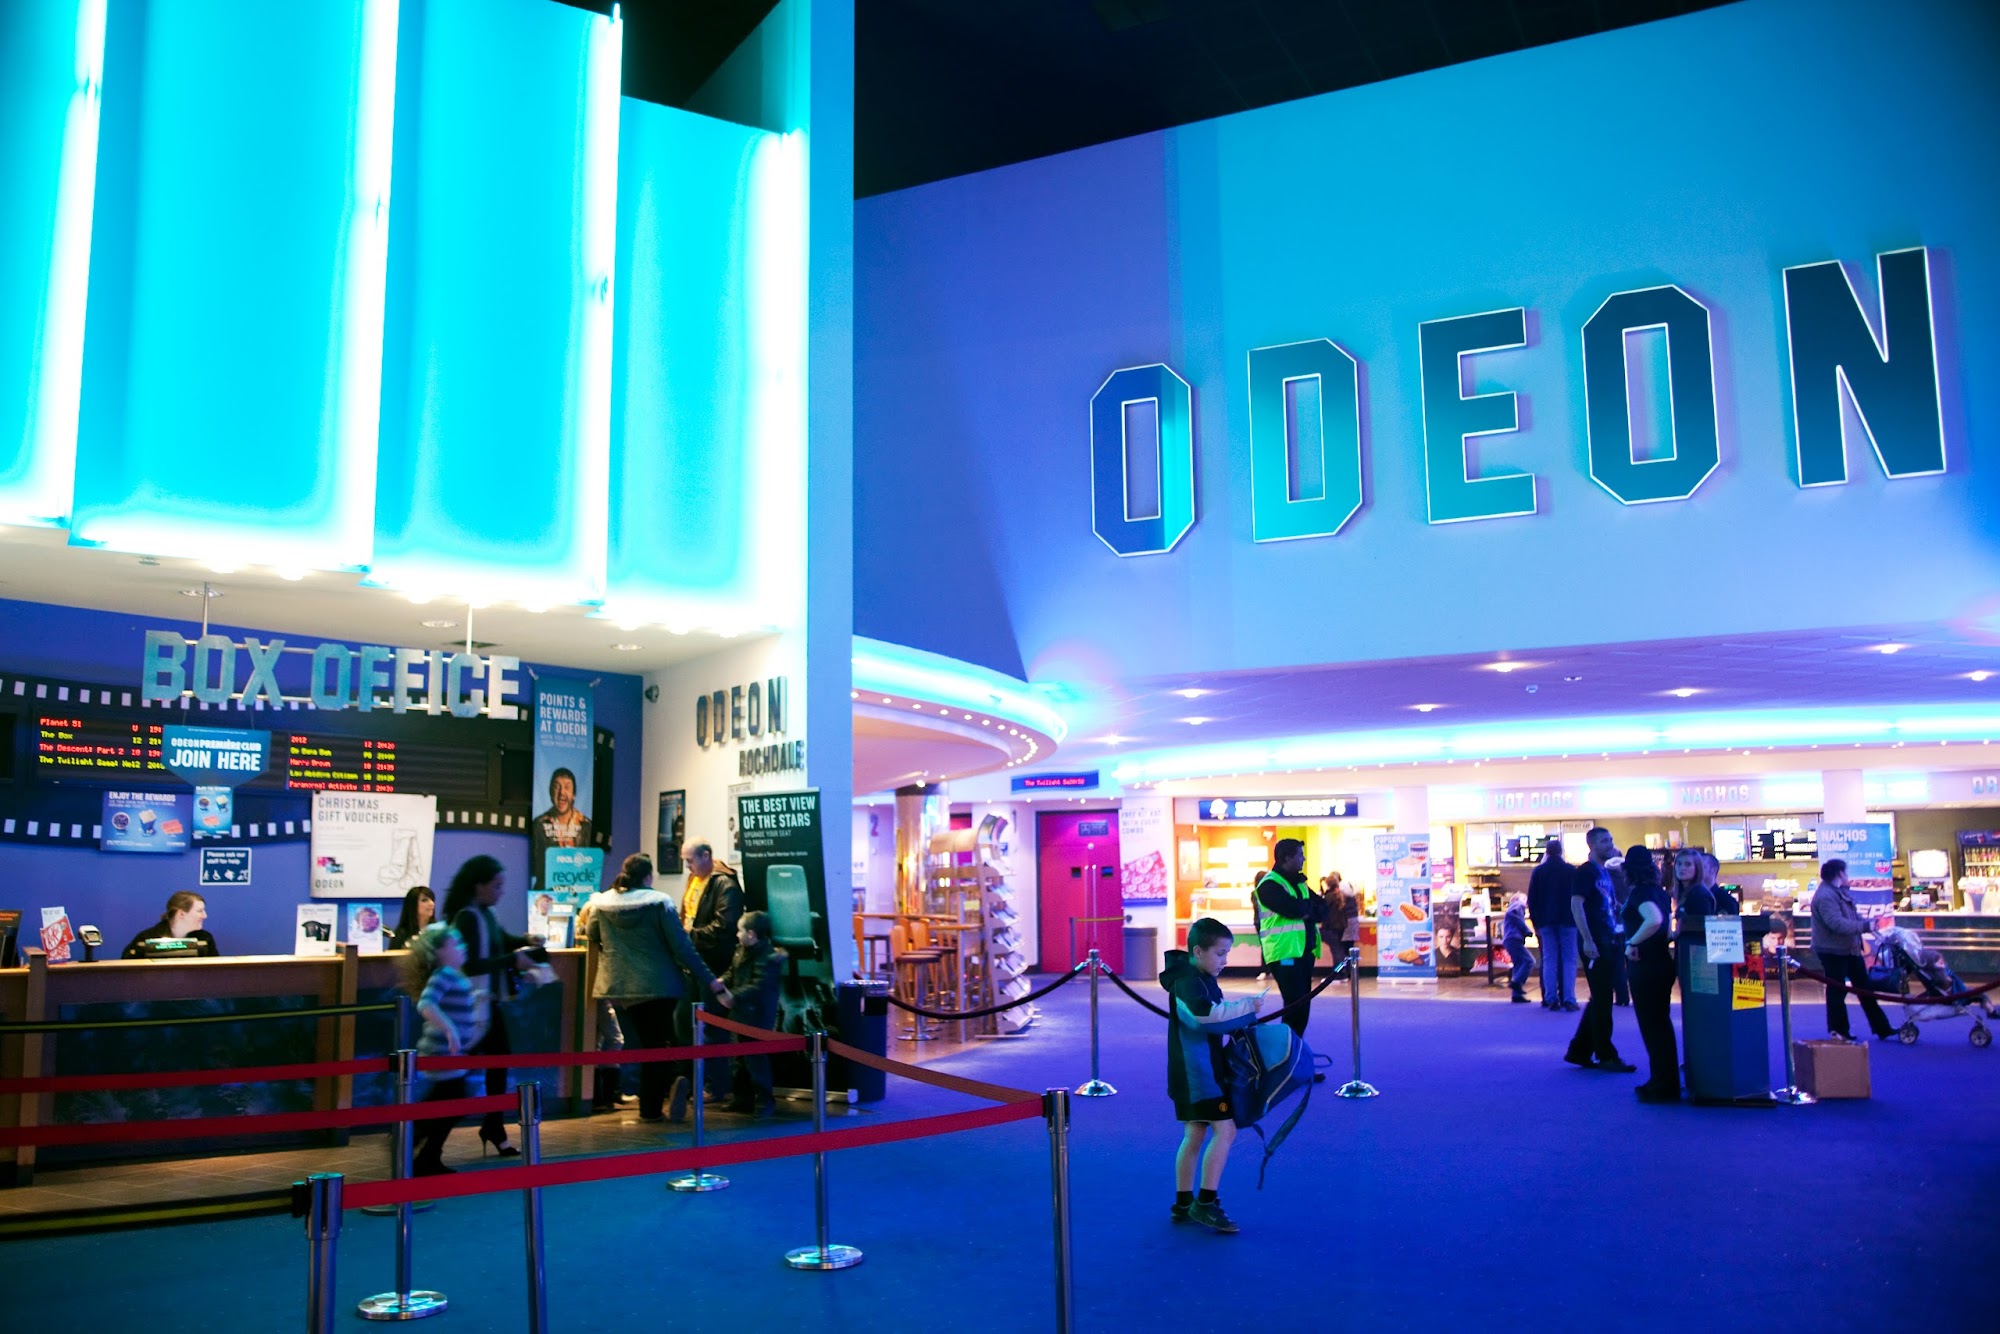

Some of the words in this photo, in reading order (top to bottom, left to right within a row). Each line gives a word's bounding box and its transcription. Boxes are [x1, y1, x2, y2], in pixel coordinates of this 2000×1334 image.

[1089, 246, 1948, 558] ODEON
[142, 629, 286, 708] BOX
[311, 643, 520, 720] OFFICE
[540, 692, 575, 708] POINTS
[578, 697, 586, 709] &
[540, 706, 587, 722] REWARDS
[696, 675, 788, 749] ODEON
[40, 718, 69, 728] Planet
[72, 720, 82, 728] 51
[132, 724, 139, 732] U
[149, 725, 162, 733] 19:
[540, 719, 552, 732] AT
[555, 721, 587, 736] ODEON
[41, 730, 55, 739] The
[58, 731, 73, 740] Box
[39, 743, 53, 752] The
[96, 746, 115, 755] Part
[118, 748, 124, 756] 2
[171, 737, 199, 748] ODEON
[241, 742, 261, 752] CLUB
[39, 755, 54, 764] The
[57, 756, 94, 766] Twilight
[169, 749, 211, 769] JOIN
[217, 751, 262, 771] HERE
[739, 740, 804, 776] ROCHDALE
[289, 780, 326, 789] Paranormal
[1972, 776, 1999, 794] DR
[108, 791, 131, 801] ENJOY
[131, 792, 143, 801] THE
[144, 793, 176, 802] REWARDS
[1495, 792, 1524, 809] HOT
[1531, 791, 1573, 809] DOGS
[1681, 784, 1750, 804] NACHOS
[318, 797, 379, 809] CHRISTMAS
[741, 799, 761, 814] THE
[763, 797, 787, 813] BEST
[789, 796, 816, 811] VIEW
[318, 811, 340, 822] GIFT
[345, 812, 399, 824] VOUCHERS
[743, 815, 756, 829] OF
[757, 814, 777, 829] THE
[778, 813, 811, 828] STARS
[870, 813, 879, 837] 2
[1374, 836, 1406, 844] POPCORN
[1820, 829, 1867, 842] NACHOS
[1821, 842, 1849, 852] COMBO
[315, 879, 344, 889] ODEON
[552, 868, 596, 884] recycle
[1855, 903, 1894, 919] EPS
